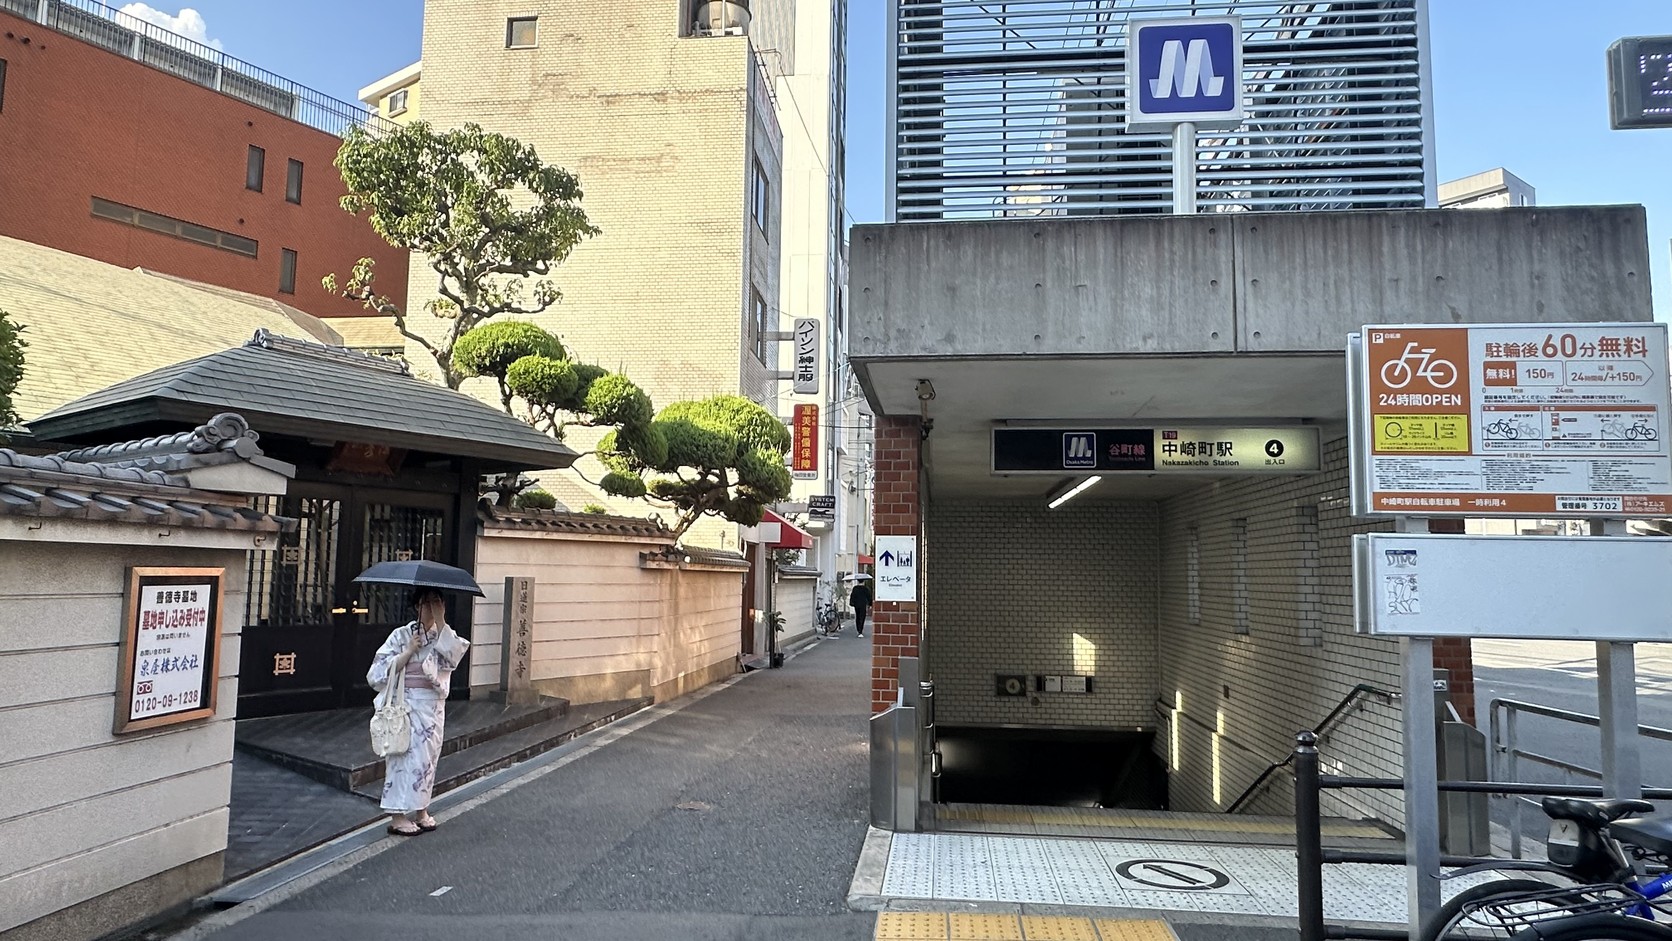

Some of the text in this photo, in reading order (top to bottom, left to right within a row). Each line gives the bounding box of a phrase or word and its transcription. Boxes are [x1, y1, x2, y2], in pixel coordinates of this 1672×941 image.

[1485, 334, 1649, 358] 駐輪後60分無料
[1525, 369, 1554, 379] 150円
[1379, 394, 1461, 406] 24時間OPEN
[1109, 444, 1146, 455] 谷町線
[1162, 441, 1233, 457] 中崎町駅
[1269, 443, 1279, 454] 4
[142, 607, 206, 630] 墓地申し込み受付中
[135, 690, 199, 713] 0120-09-1238
